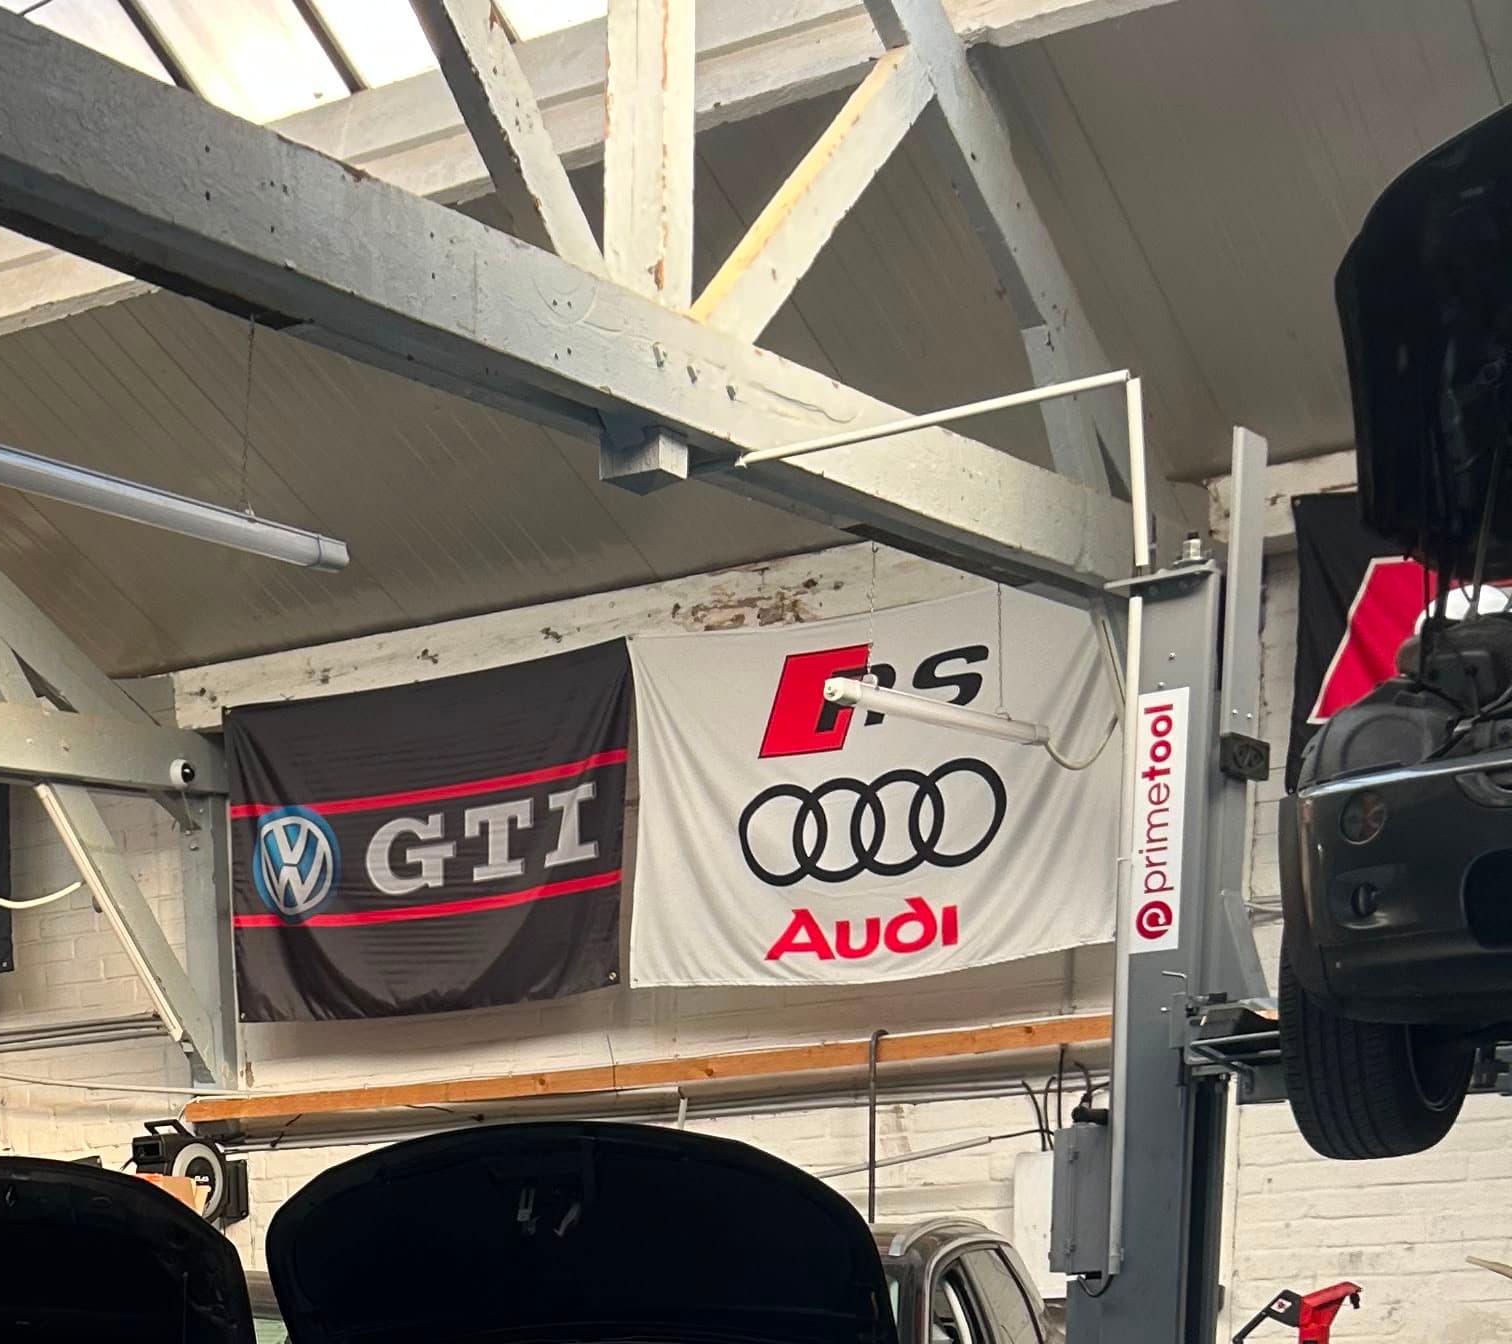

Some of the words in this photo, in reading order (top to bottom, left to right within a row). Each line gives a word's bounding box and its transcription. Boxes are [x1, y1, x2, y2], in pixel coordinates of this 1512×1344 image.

[366, 782, 599, 895] GTI
[1138, 703, 1175, 894] primetool
[764, 897, 959, 961] Audi
